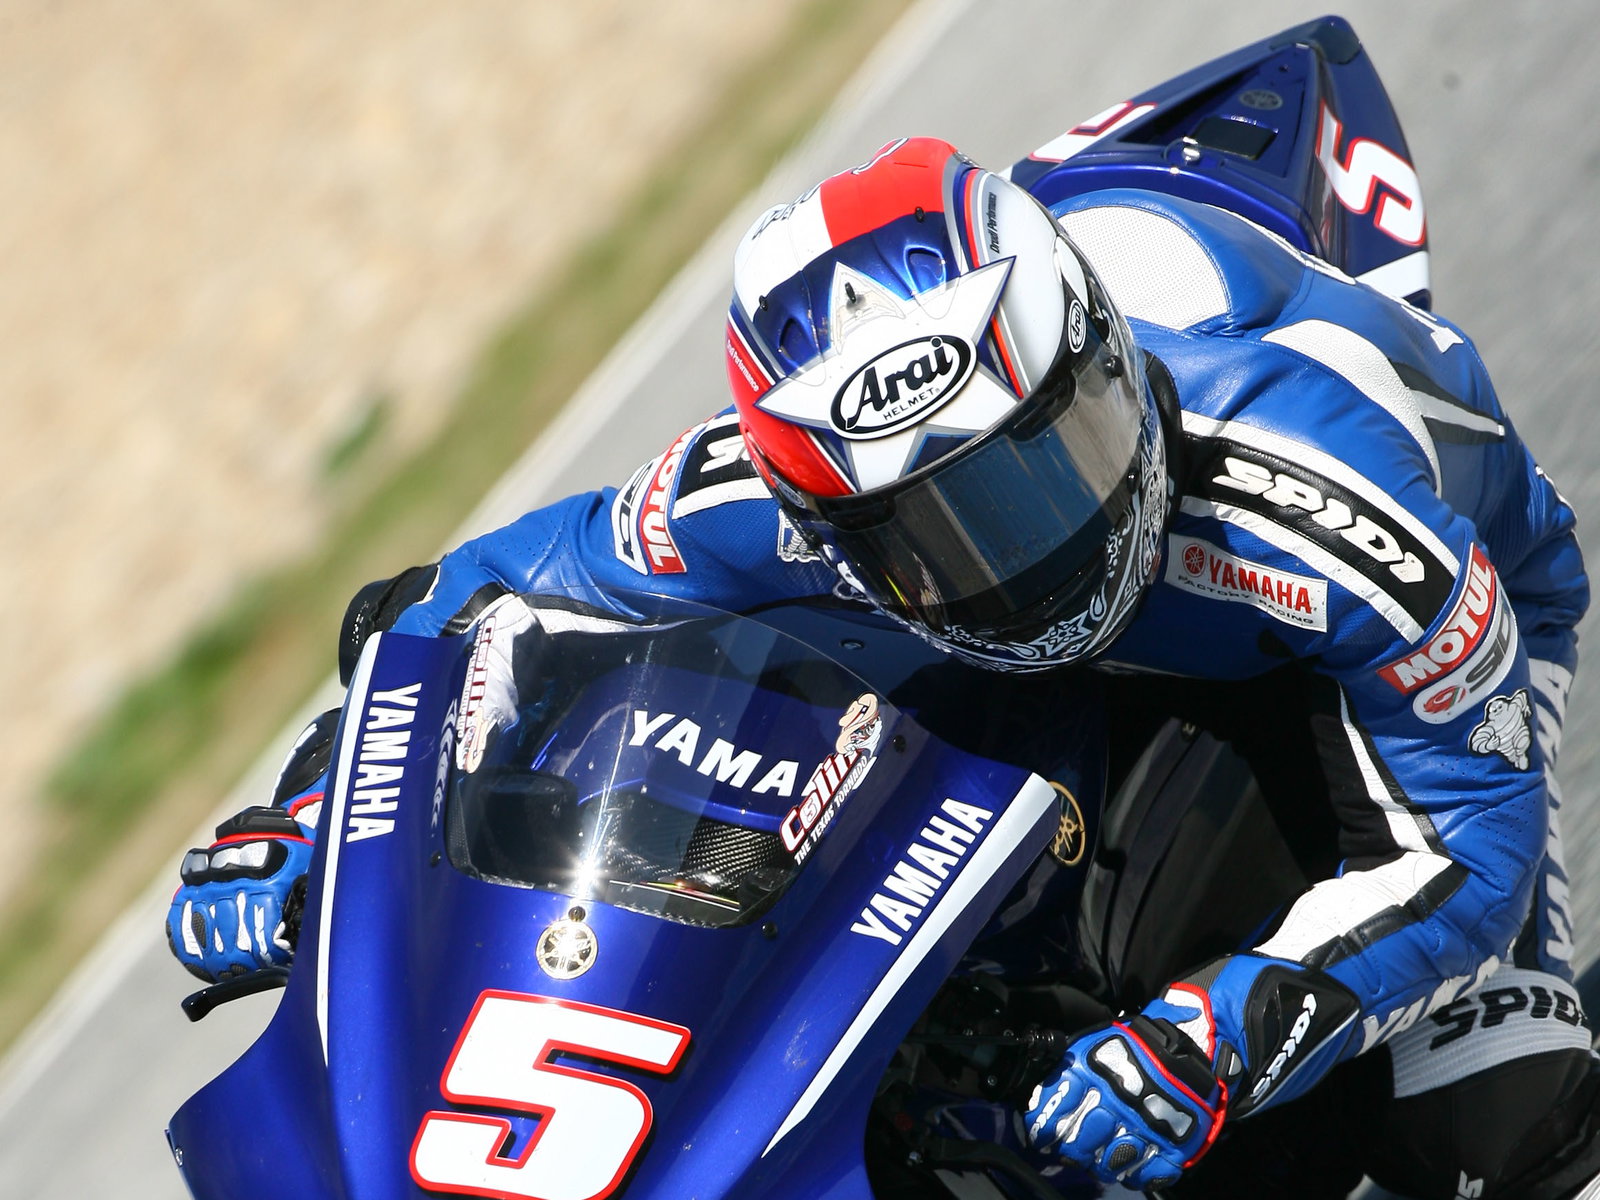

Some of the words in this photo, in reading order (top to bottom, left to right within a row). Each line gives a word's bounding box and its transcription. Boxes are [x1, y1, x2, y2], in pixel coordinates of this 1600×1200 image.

[1315, 97, 1428, 247] 5
[846, 337, 954, 429] Arai
[883, 388, 935, 421] HELMET
[1212, 456, 1426, 584] SPIDI
[1178, 575, 1250, 599] FACTORY
[1258, 599, 1314, 624] RACING
[1209, 554, 1313, 614] YAMAHA
[1392, 560, 1492, 689] MOTUL
[345, 682, 423, 843] YAMAHA
[794, 841, 812, 866] THE
[810, 806, 836, 843] TEXAS
[835, 756, 868, 809] TORNADO
[851, 798, 994, 946] YAMAHA
[1250, 993, 1317, 1103] SPIDI
[1429, 985, 1582, 1050] SPID
